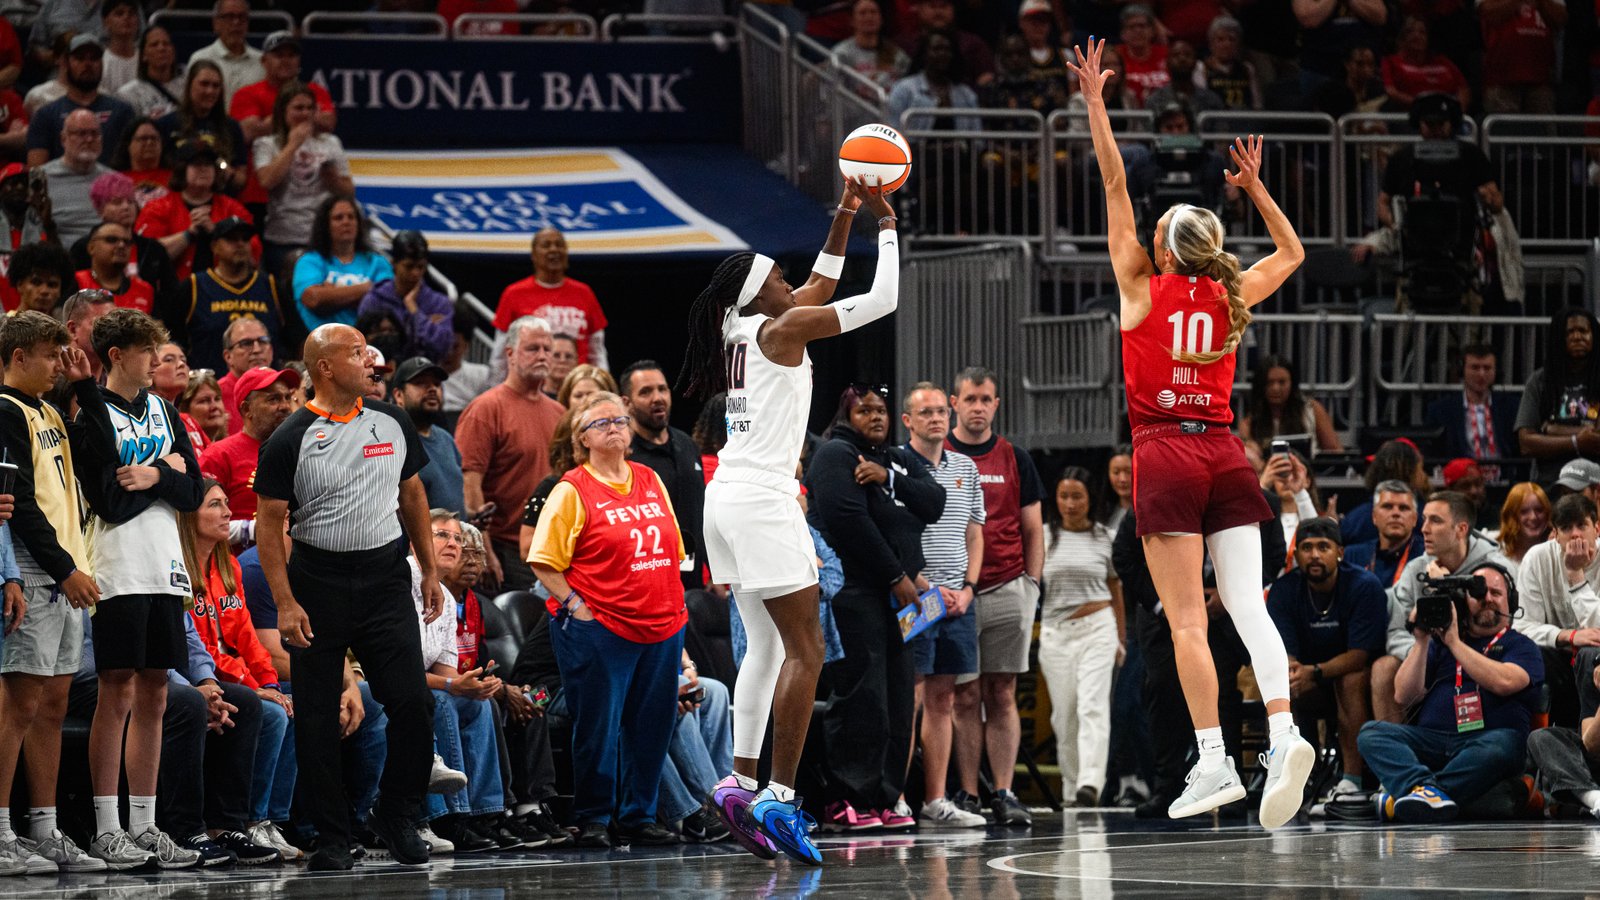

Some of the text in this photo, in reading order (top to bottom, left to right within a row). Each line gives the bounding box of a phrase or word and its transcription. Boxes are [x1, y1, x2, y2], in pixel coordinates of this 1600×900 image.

[541, 71, 686, 112] BANK
[433, 190, 549, 207] OLD
[365, 202, 647, 219] NATIONAL
[211, 301, 268, 313] INDIANA
[1168, 311, 1213, 360] 10
[1172, 367, 1199, 385] HULL
[1178, 394, 1212, 406] AT&T
[731, 420, 751, 432] AT&T
[119, 434, 165, 466] INDY
[363, 445, 393, 456] Emirates
[605, 502, 665, 525] FEVER
[630, 525, 664, 558] 22
[631, 558, 671, 572] salesforce
